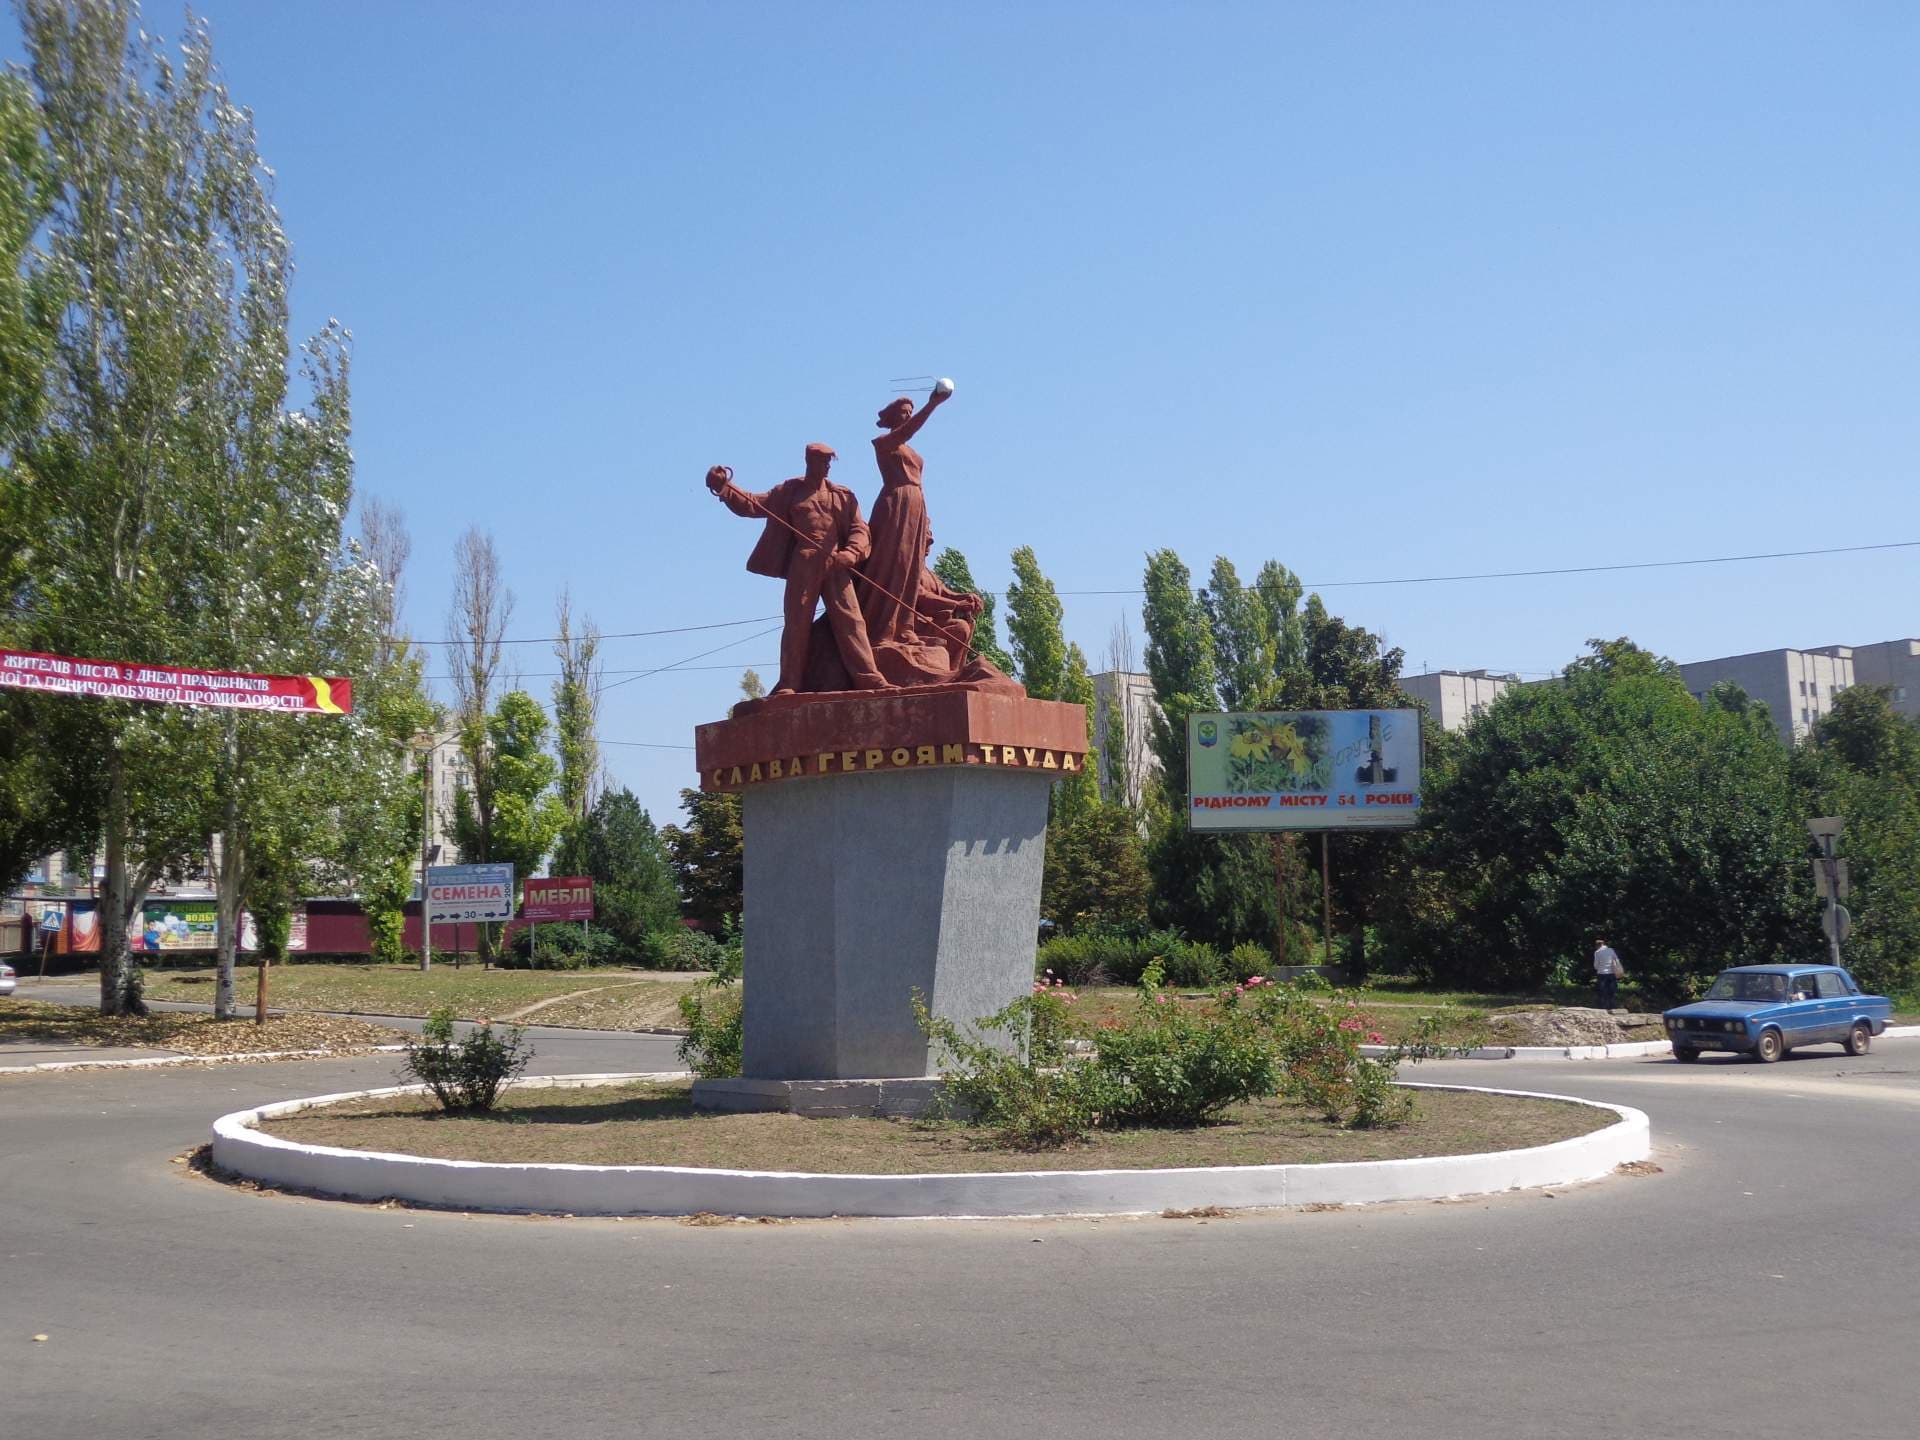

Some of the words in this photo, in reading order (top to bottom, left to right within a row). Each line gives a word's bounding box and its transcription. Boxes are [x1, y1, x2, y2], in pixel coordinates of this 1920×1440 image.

[3, 654, 71, 674] ЖИТЕЛІВ
[74, 663, 119, 680] МІСТА
[136, 669, 177, 685] ДНЕМ
[181, 673, 269, 692] ПРАЦІВНИКІВ
[23, 673, 41, 688] ТА
[185, 689, 304, 708] ПРОМИСЛОВОСТІ!
[713, 757, 802, 786] СЛАВА
[818, 743, 964, 772] ГЕРОЯМ
[979, 744, 1076, 772] ТРУДА
[1193, 795, 1271, 809] РІДНОМУ
[1279, 794, 1328, 808] МІСТУ
[1337, 794, 1356, 806] 54
[1365, 793, 1414, 805] РОКИ
[431, 885, 502, 901] СЕМЕНА
[530, 887, 590, 906] МЕБЛІ
[464, 911, 476, 919] 30
